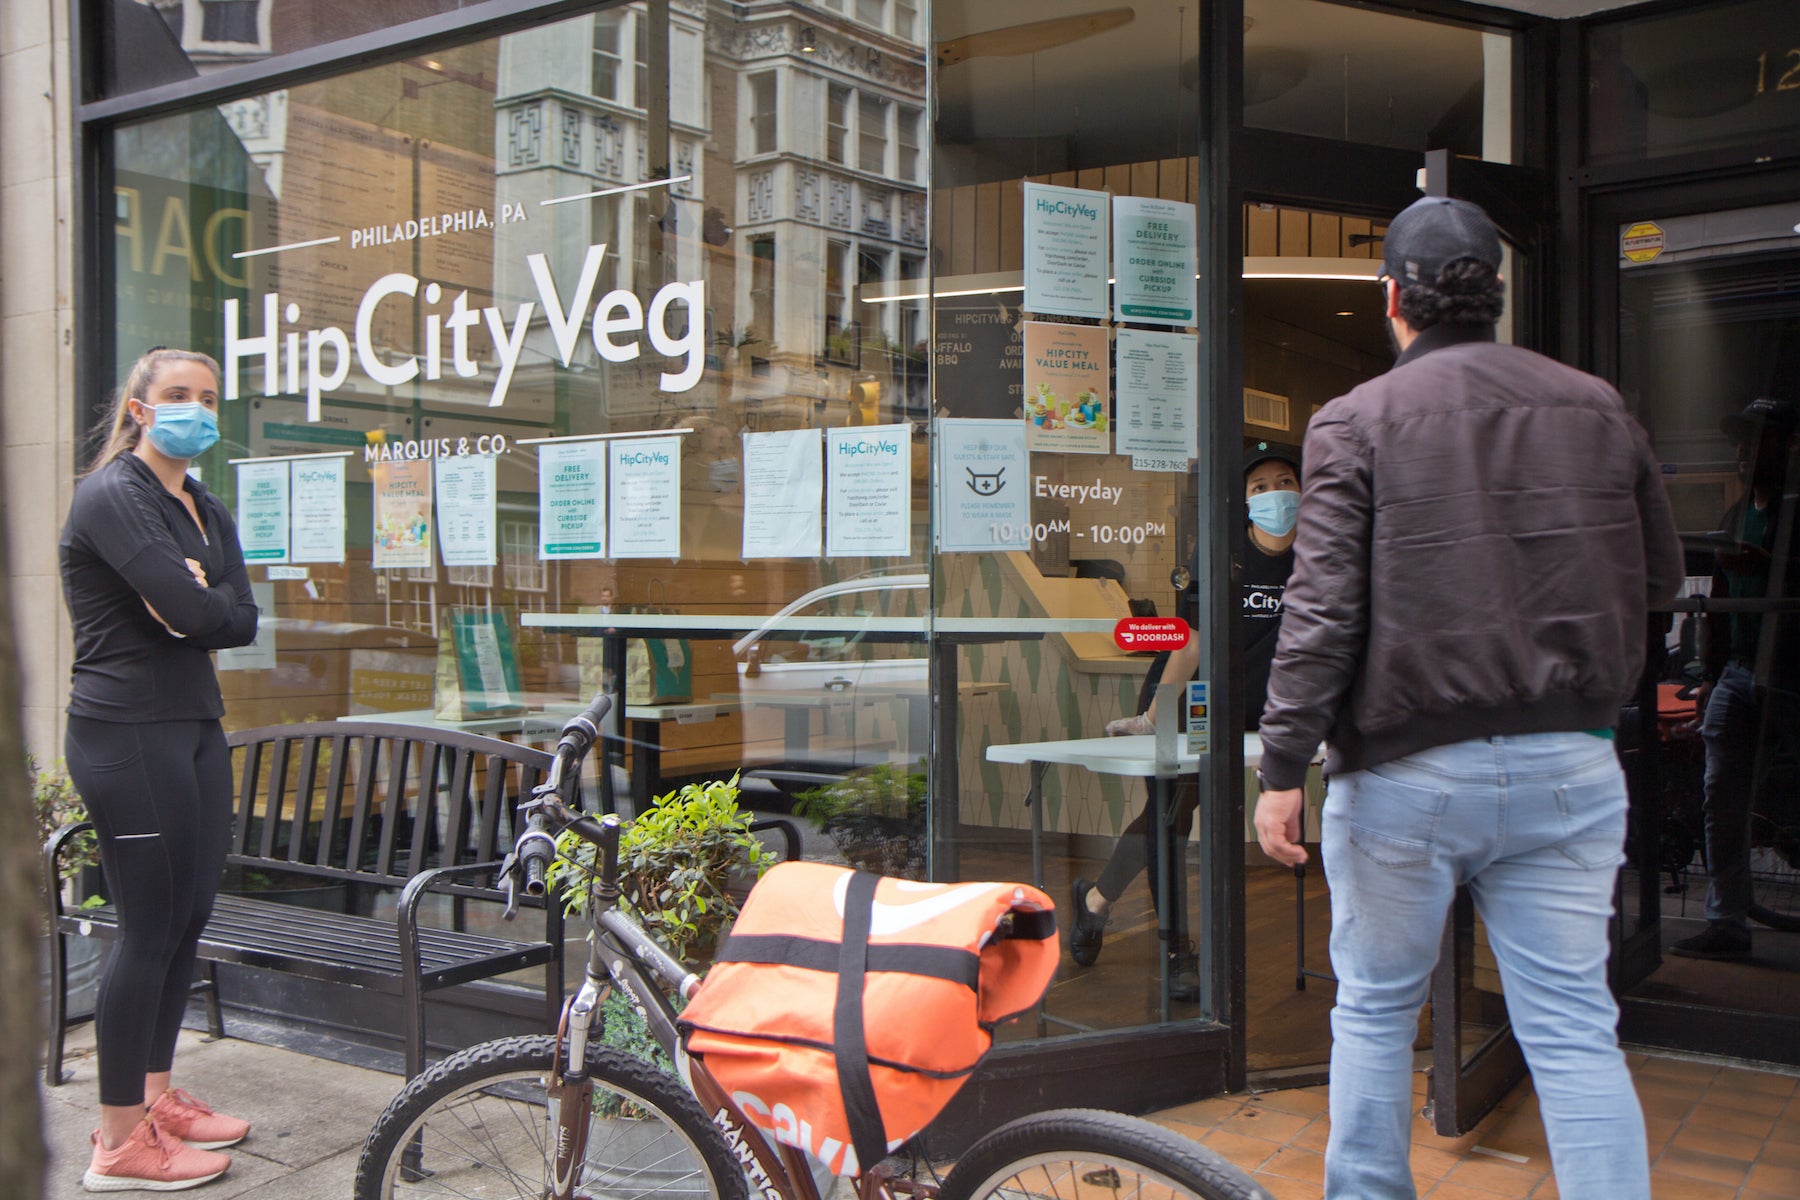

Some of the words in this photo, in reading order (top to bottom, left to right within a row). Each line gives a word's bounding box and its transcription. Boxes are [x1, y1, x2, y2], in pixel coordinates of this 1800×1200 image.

[1036, 199, 1097, 221] HipCityVeg
[351, 208, 495, 249] PHILADELPHIA,
[501, 201, 527, 223] PA
[1147, 222, 1169, 231] FREE
[1136, 230, 1179, 241] DELIVERY
[1129, 257, 1156, 266] ORDER
[1157, 260, 1185, 269] ONLINE
[1139, 275, 1176, 284] CURBSIDE
[1144, 284, 1172, 293] PICKUP
[224, 243, 705, 423] HipCityVeg
[937, 354, 958, 365] BBQ
[1046, 349, 1089, 359] HIPCITY
[1036, 359, 1069, 369] VALUE
[1072, 361, 1100, 371] MEAL
[364, 438, 451, 463] MARQUIS
[457, 437, 470, 456] &
[477, 434, 511, 455] CO.
[839, 440, 898, 457] HipCityVeg
[620, 452, 669, 467] HipCityVeg
[1134, 458, 1188, 471] 215-278-7605
[564, 465, 581, 473] FREE
[299, 471, 337, 483] HipCityVeg
[555, 473, 589, 482] DELIVERY
[389, 481, 417, 489] HIPCITY
[1035, 475, 1123, 506] Everyday
[382, 490, 404, 498] VALUE
[406, 489, 425, 497] MEAL
[550, 499, 571, 507] ORDER
[572, 498, 595, 506] ONLINE
[557, 514, 588, 522] CURBSIDE
[1136, 633, 1184, 642] DOORDASH
